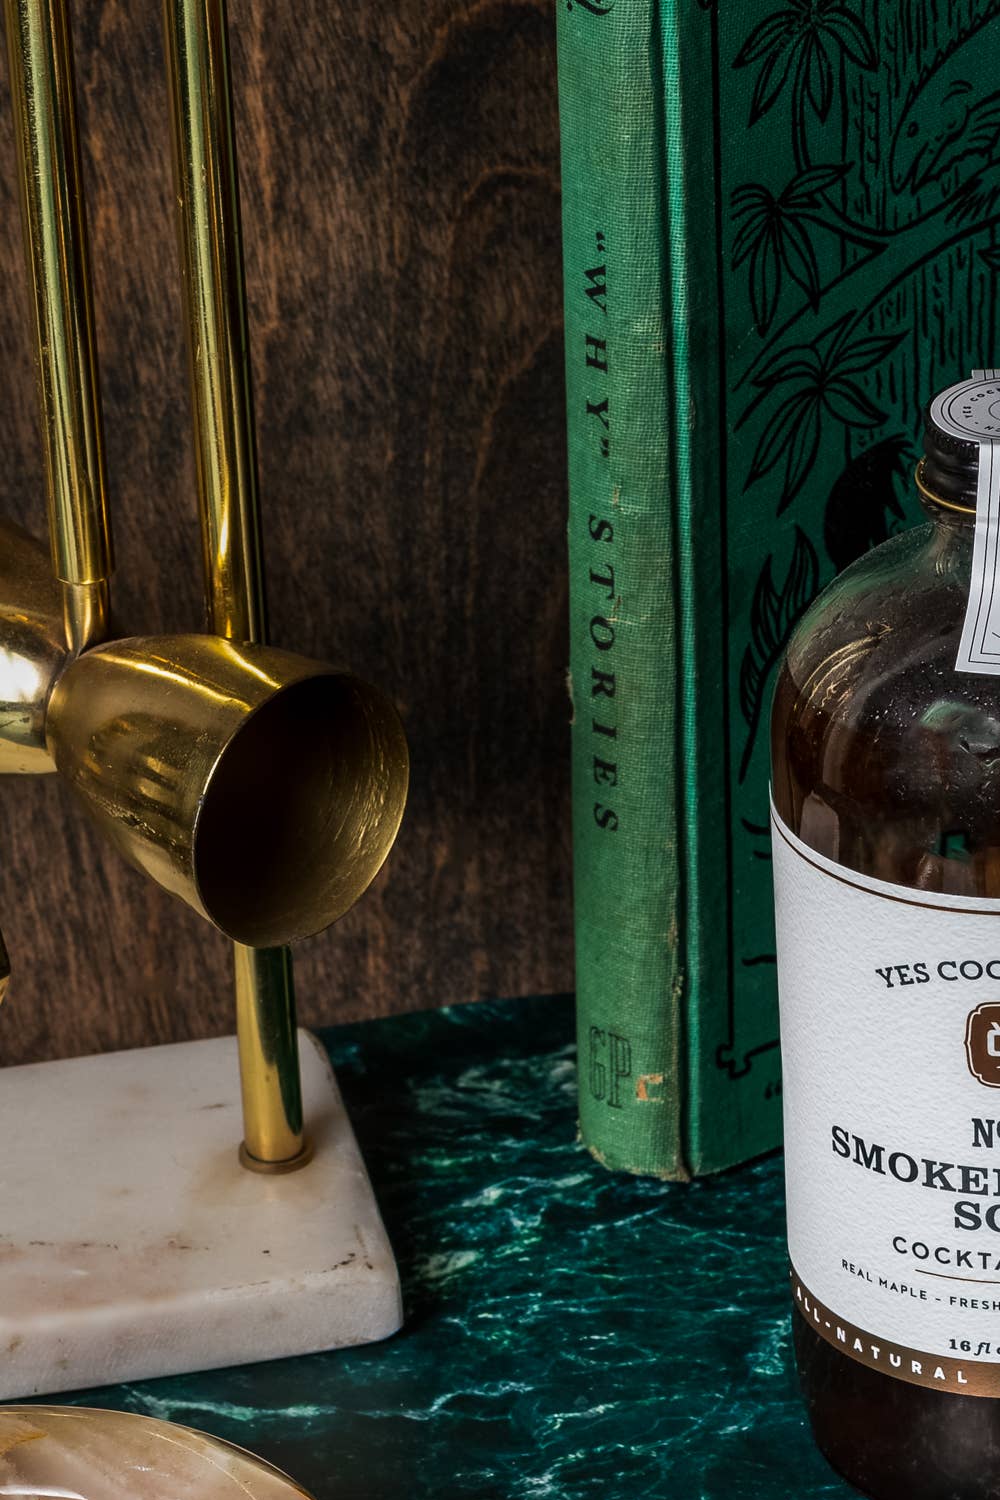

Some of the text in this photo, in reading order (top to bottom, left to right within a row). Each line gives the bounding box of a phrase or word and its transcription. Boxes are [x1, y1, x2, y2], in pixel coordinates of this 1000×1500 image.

[588, 513, 618, 832] STORIES
[875, 962, 930, 988] YES
[841, 1258, 873, 1283] REAL
[879, 1278, 928, 1301] MAPLE
[949, 1296, 1000, 1311] FRESH
[797, 1286, 968, 1384] ALL-NATURAL
[949, 1338, 971, 1352] 16
[974, 1341, 991, 1356] fl
